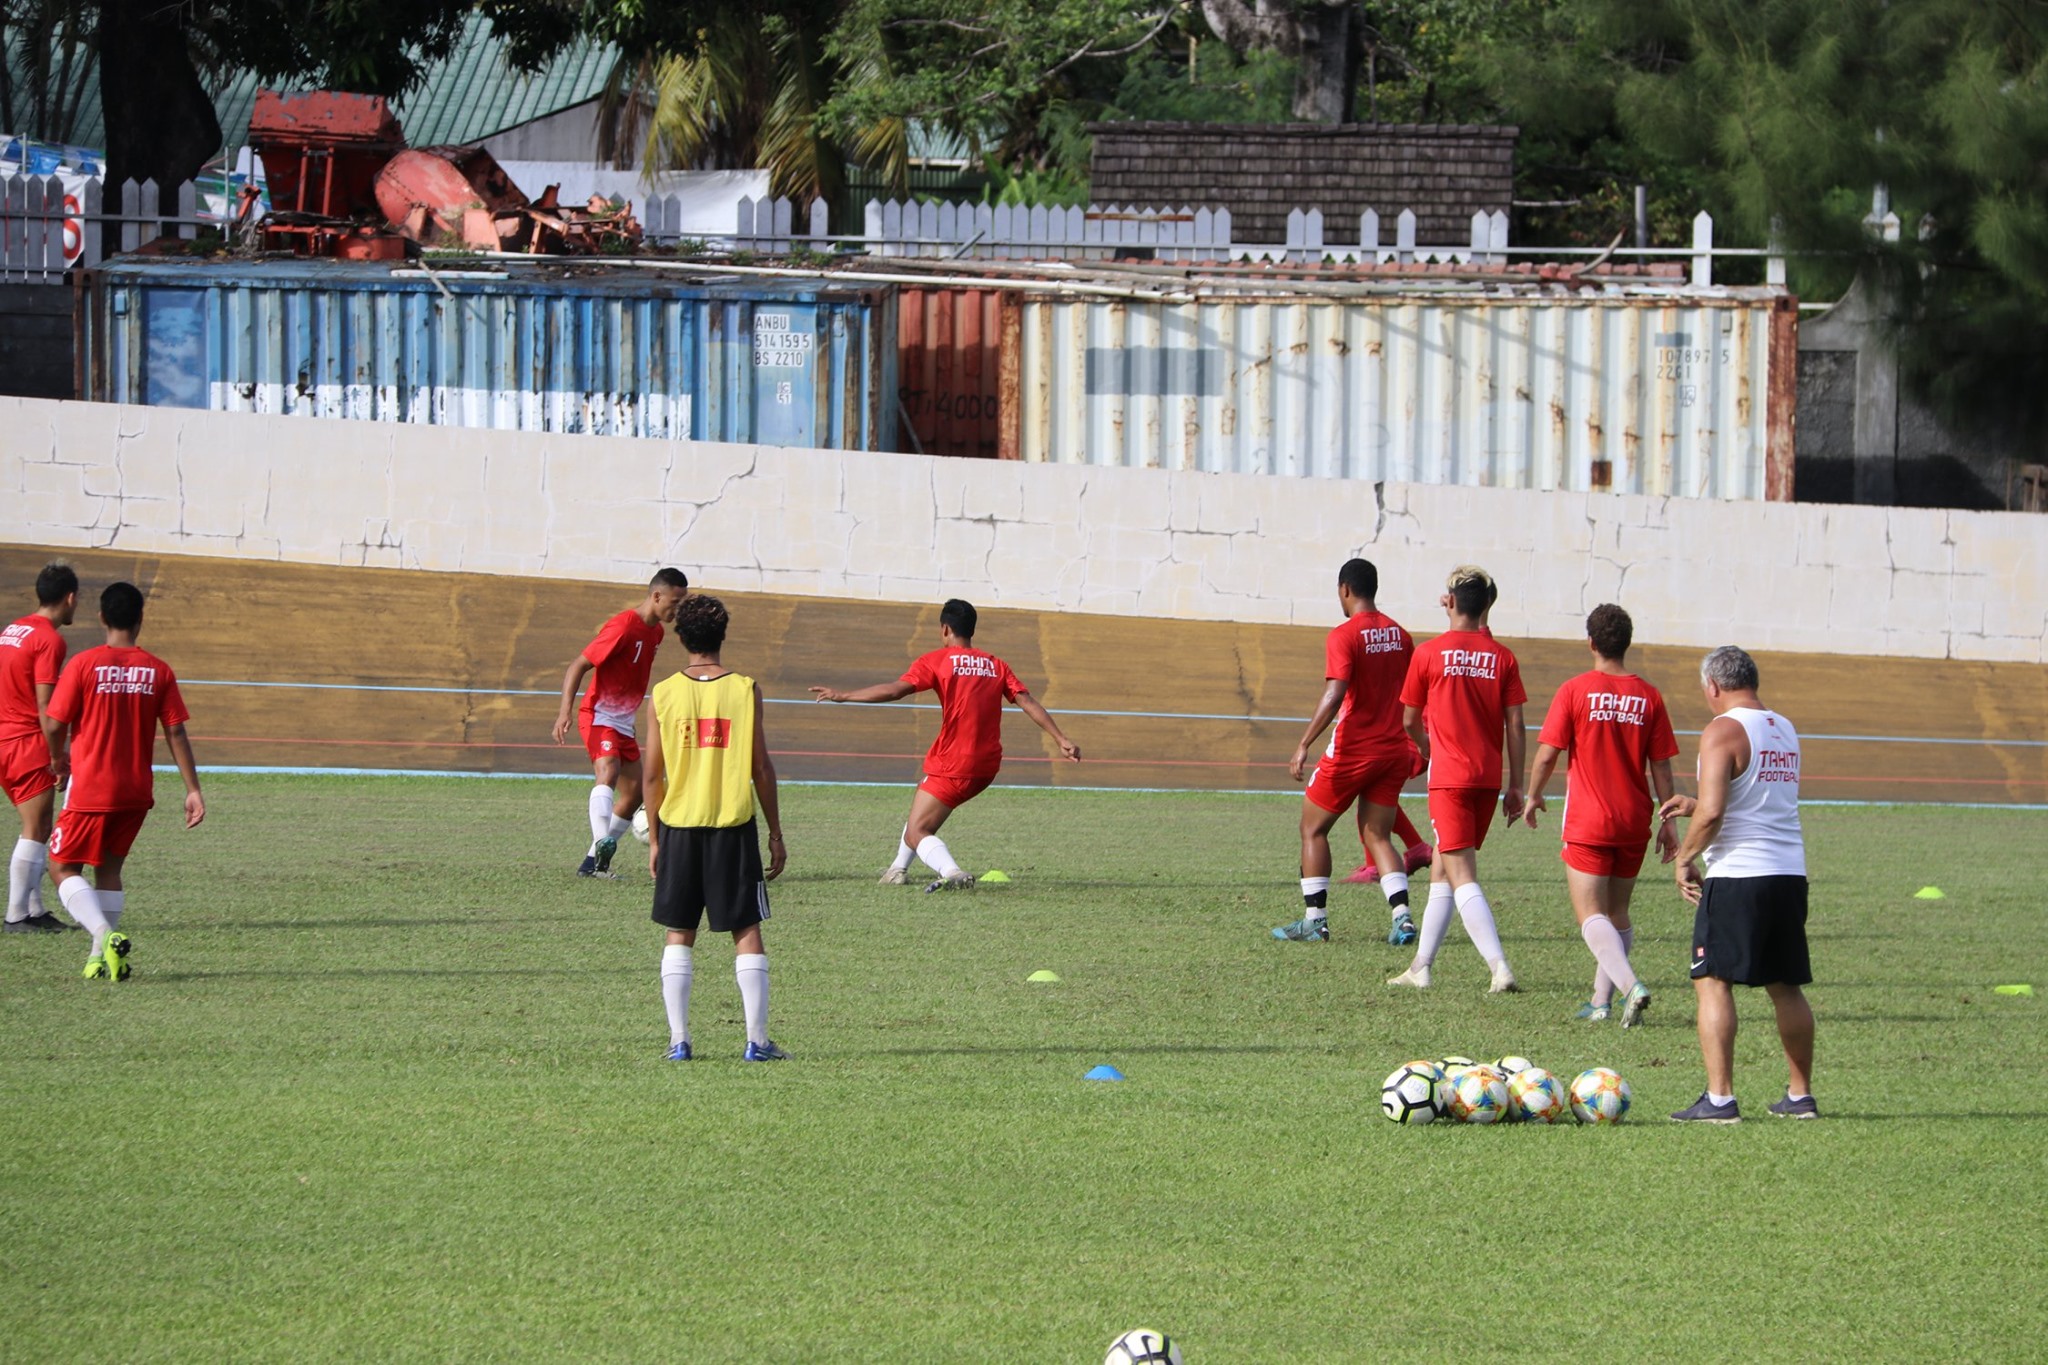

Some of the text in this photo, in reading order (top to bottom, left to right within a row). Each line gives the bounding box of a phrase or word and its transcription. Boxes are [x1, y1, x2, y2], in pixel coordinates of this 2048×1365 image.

[755, 315, 787, 330] ANBU
[755, 334, 776, 348] 514
[755, 352, 803, 366] BS 2210
[1659, 349, 1710, 363] 107897
[1360, 626, 1401, 644] TAHITI
[633, 641, 643, 664] 7
[1365, 641, 1403, 654] FOOTBALL
[950, 654, 994, 669] TAHITI
[1441, 650, 1496, 668] TAHITI
[95, 666, 155, 683] TAHITI
[952, 666, 997, 678] FOOTBALL
[1443, 665, 1496, 680] FOOTBALL
[96, 682, 154, 695] FOOTBALL
[1587, 692, 1647, 714] TAHITI
[1588, 710, 1645, 726] FOOTBALL
[1759, 750, 1799, 769] TAHITI
